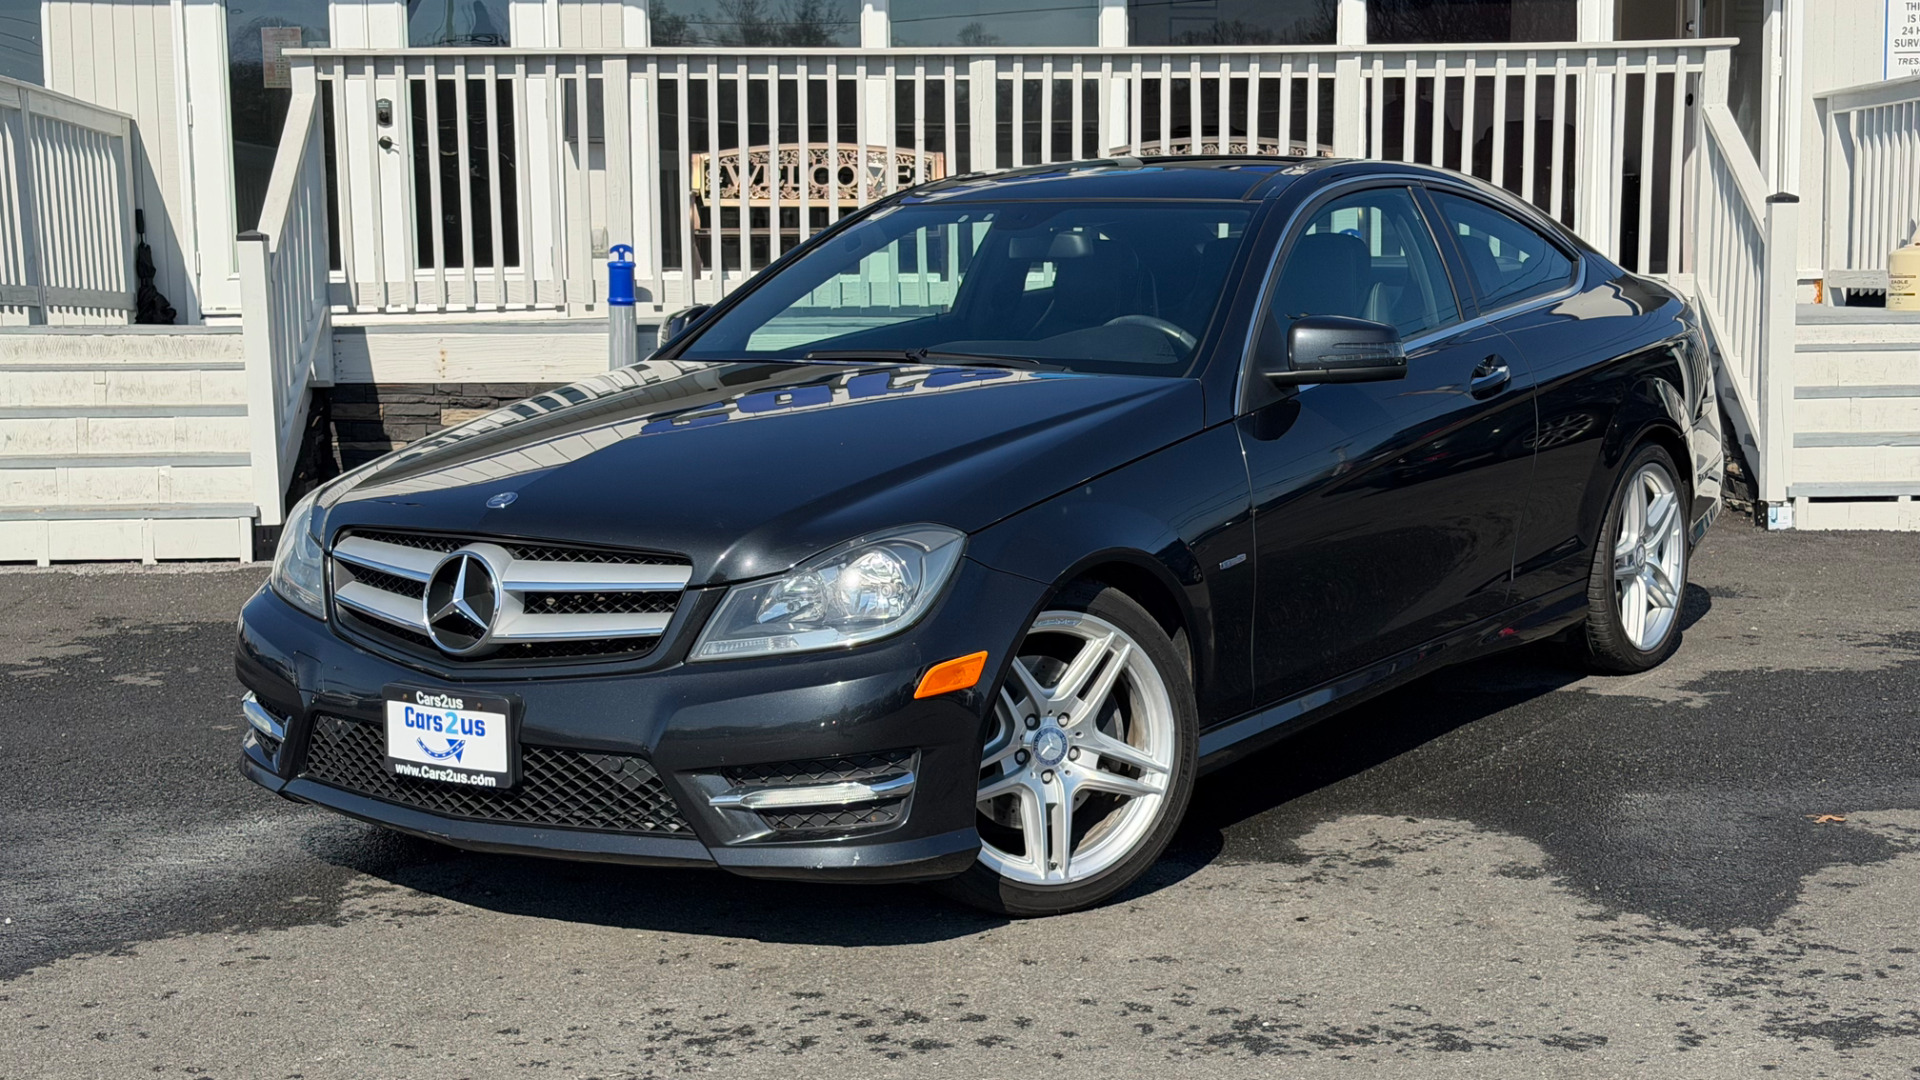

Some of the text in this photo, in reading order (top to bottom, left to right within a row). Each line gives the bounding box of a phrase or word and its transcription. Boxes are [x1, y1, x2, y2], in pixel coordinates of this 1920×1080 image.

[1907, 14, 1917, 23] IS
[1902, 26, 1914, 35] 24
[416, 691, 463, 709] Cars2us
[405, 706, 485, 737] Cars2us
[395, 763, 496, 787] www.Cars2us.com
